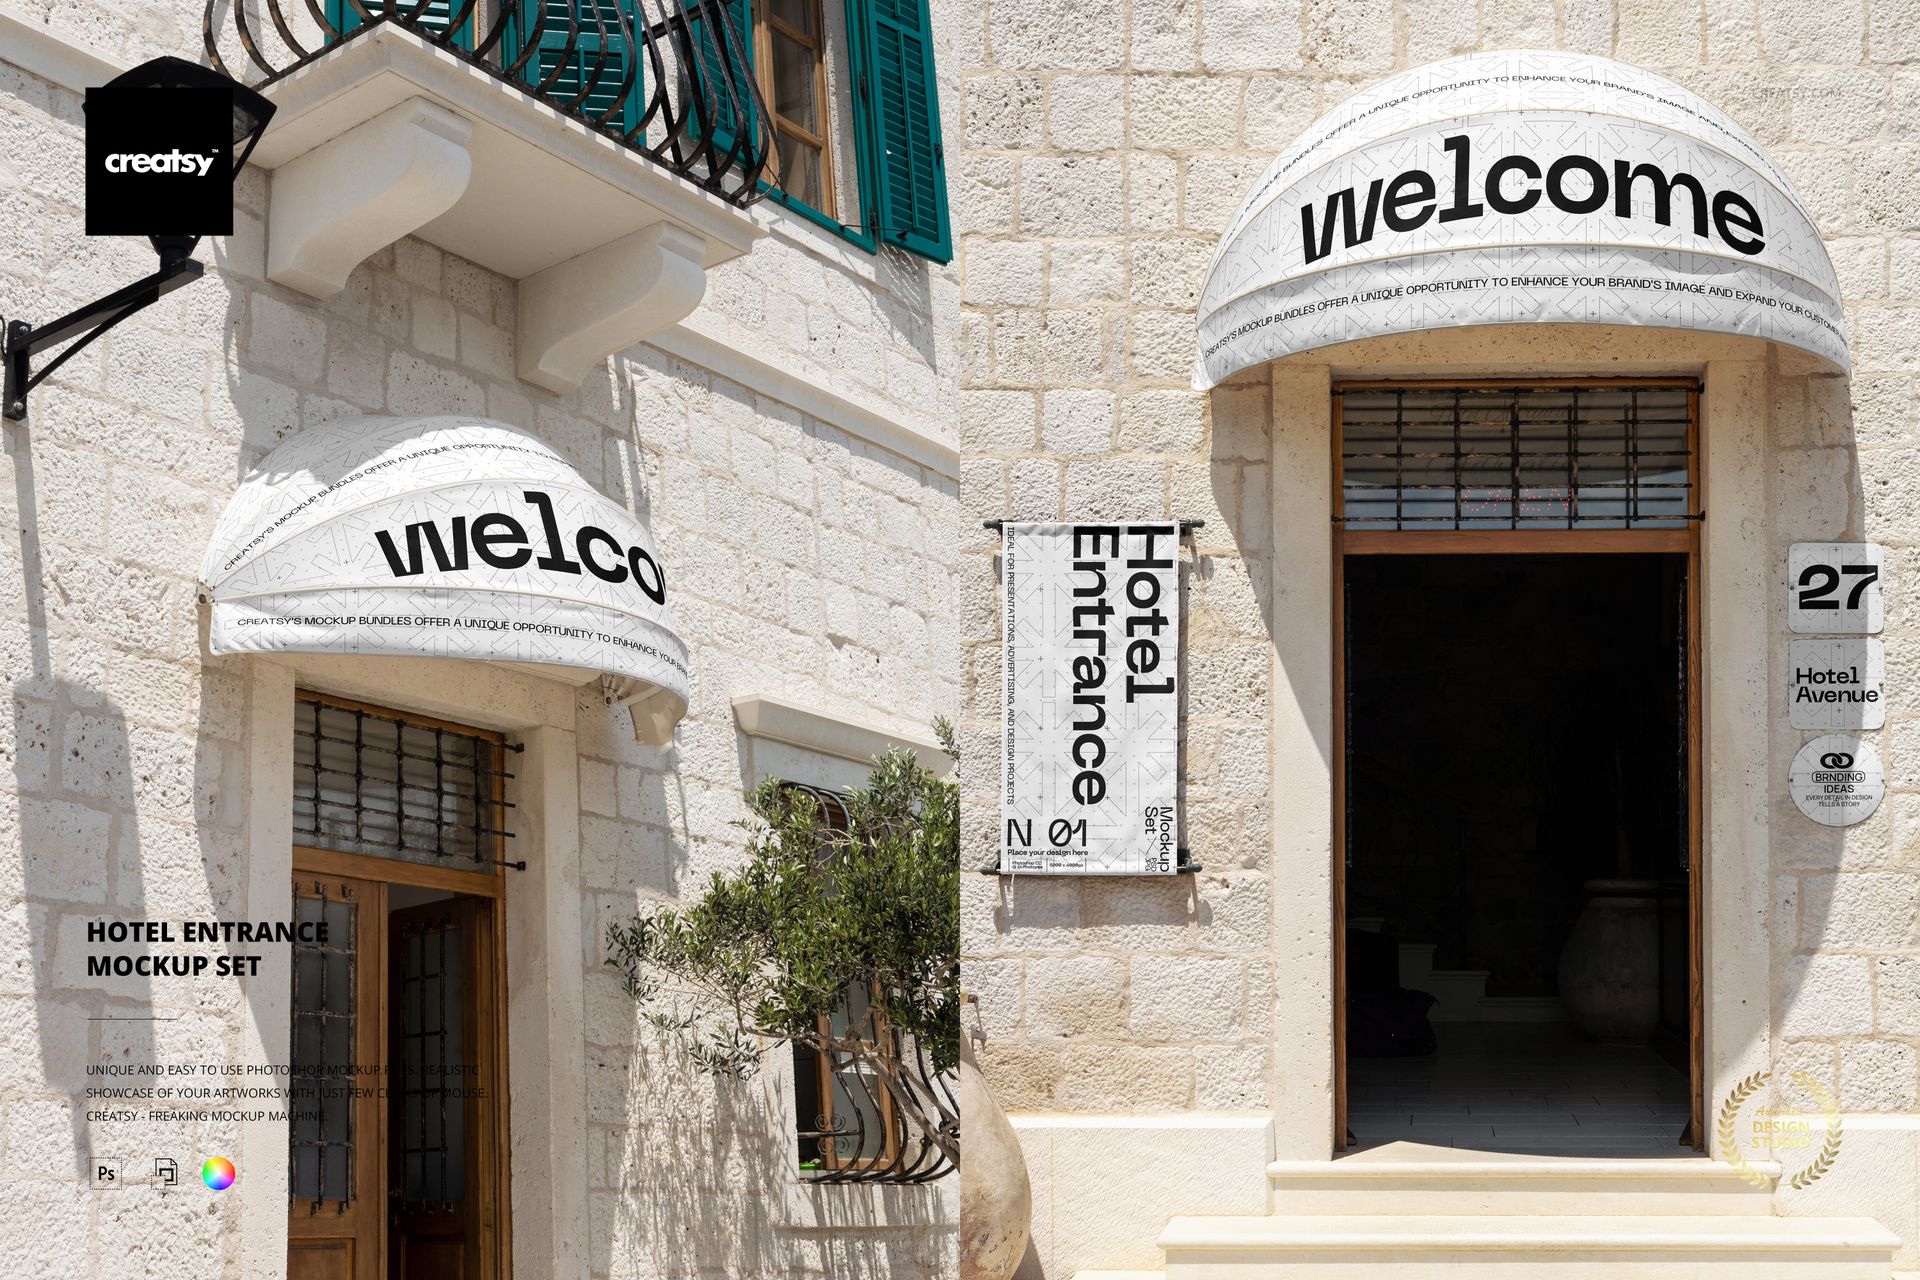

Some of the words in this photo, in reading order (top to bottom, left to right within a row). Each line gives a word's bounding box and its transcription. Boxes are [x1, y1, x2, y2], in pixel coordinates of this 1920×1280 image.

[1325, 118, 1357, 140] OFFER
[1359, 112, 1366, 121] A
[1368, 95, 1410, 115] UNIQUE
[1411, 77, 1490, 100] OPPORTUNITY
[1493, 75, 1510, 83] TO
[1512, 74, 1567, 83] ENHANCE
[1569, 76, 1602, 87] YOUR
[1603, 80, 1655, 101] BRAND'S
[1657, 97, 1697, 117] IMAGE
[1300, 134, 1767, 264] welcome
[1237, 316, 1273, 337] MOCKUP
[1274, 305, 1316, 323] BUNDLES
[1317, 297, 1349, 311] OFFER
[1351, 295, 1360, 305] A
[1361, 286, 1404, 302] UNIQUE
[1406, 277, 1489, 295] OPPORTUNITY
[1492, 277, 1508, 287] TO
[1511, 276, 1569, 287] ENHANCE
[1572, 276, 1606, 287] YOUR
[1608, 276, 1662, 290] BRAND'S
[1665, 281, 1706, 294] IMAGE
[1708, 286, 1734, 298] AND
[1735, 290, 1777, 308] EXPAND
[1778, 299, 1804, 316] YOUR
[224, 525, 275, 571] CREATSY'S
[274, 496, 317, 528] MOCKUP
[317, 472, 364, 499] BUNDLES
[364, 459, 397, 476] OFFER
[398, 455, 408, 463] A
[406, 444, 450, 460] UNIQUE
[452, 443, 531, 454] OPPORTUNITY
[374, 491, 667, 606] welco
[1007, 526, 1015, 551] IDEAL
[1007, 552, 1015, 570] FOR
[1006, 571, 1015, 643] PRESENTATIONS,
[1798, 564, 1879, 610] 27
[1125, 526, 1175, 704] Hotel
[237, 617, 302, 626] CREATSY'S
[304, 616, 357, 625] MOCKUP
[358, 616, 412, 626] BUNDLES
[414, 616, 451, 627] OFFER
[453, 618, 462, 628] A
[464, 618, 510, 631] UNIQUE
[512, 621, 594, 640] OPPORTUNITY
[596, 632, 611, 644] TO
[612, 637, 658, 657] ENHANCE
[1006, 645, 1015, 707] ADVERTISING,
[1072, 526, 1120, 806] Entrance
[1796, 667, 1860, 685] Hotel
[1796, 686, 1879, 703] Avenue
[1007, 707, 1015, 727] AND
[1007, 728, 1015, 761] DESIGN
[1007, 762, 1015, 805] PROJECTS
[1815, 772, 1863, 782] BRNDING
[1823, 784, 1855, 794] IDEAS
[1007, 819, 1032, 847] N
[1145, 806, 1159, 835] Set
[1157, 806, 1173, 873] Mockup
[1046, 849, 1072, 857] design
